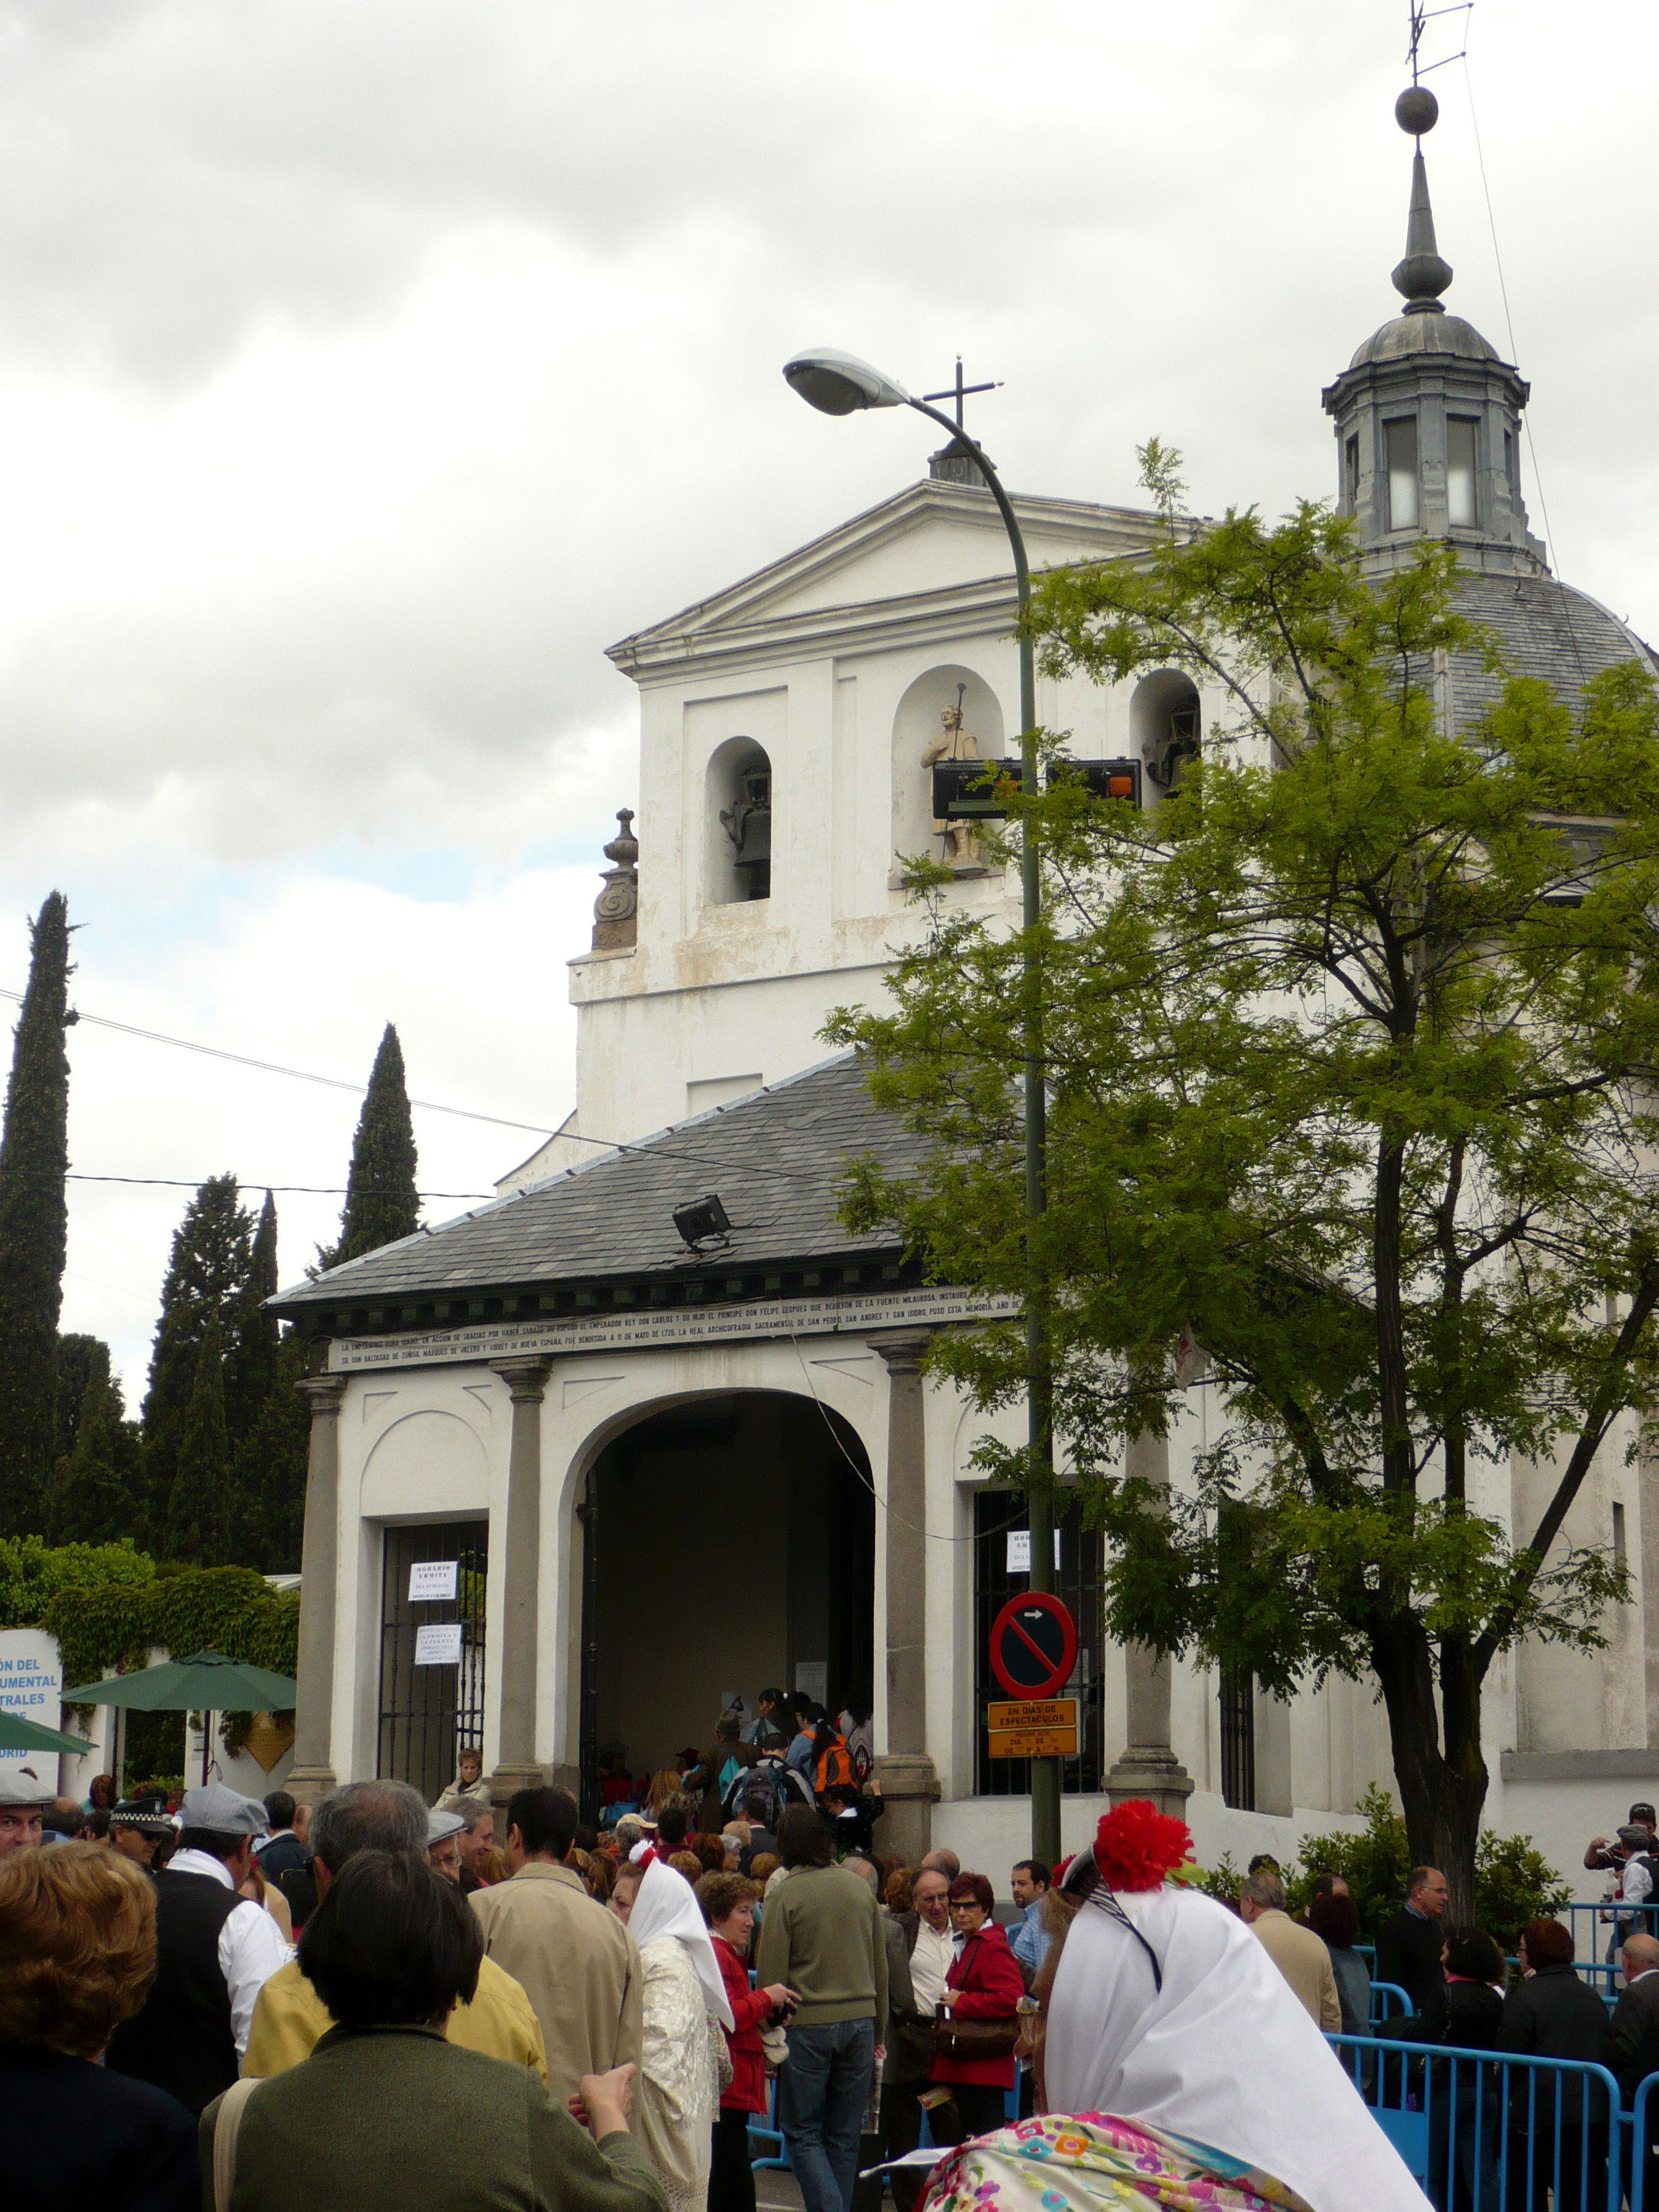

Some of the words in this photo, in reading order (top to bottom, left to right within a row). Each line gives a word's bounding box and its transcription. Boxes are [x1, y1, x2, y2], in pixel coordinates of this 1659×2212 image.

[433, 1334, 451, 1343] ACCION
[463, 1331, 486, 1340] GRACIAS
[502, 1328, 519, 1337] HABER
[547, 1324, 554, 1333] SU
[557, 1322, 577, 1332] ESPOSO
[589, 1319, 621, 1329] EMPERADOR
[652, 1316, 673, 1324] CARLOS
[692, 1312, 705, 1321] HIJO
[718, 1310, 742, 1319] PRINCIPE
[760, 1307, 779, 1316] FELIPE
[782, 1305, 807, 1315] DESPUES
[825, 1301, 853, 1310] BEBIERON
[877, 1297, 900, 1305] FUENTE
[364, 1354, 390, 1362] BALTASAR
[423, 1348, 448, 1357] MARQUES
[461, 1345, 480, 1354] VALERO
[520, 1340, 537, 1349] NUEVA
[578, 1334, 607, 1344] BENDECIDA
[708, 1323, 751, 1334] ARCHICOFRADIA
[755, 1320, 794, 1330] SACRAMENTAL
[807, 1317, 819, 1326] SAN
[860, 1312, 883, 1321] ANDRES
[948, 1305, 962, 1314] ESTA
[997, 1300, 1009, 1309] AÑO
[17, 1658, 40, 1671] DEL
[0, 1675, 57, 1689] UMENTAL
[0, 1693, 45, 1706] TRALES
[1008, 1707, 1019, 1716] EN
[999, 1714, 1064, 1726] ESPECTACULOS
